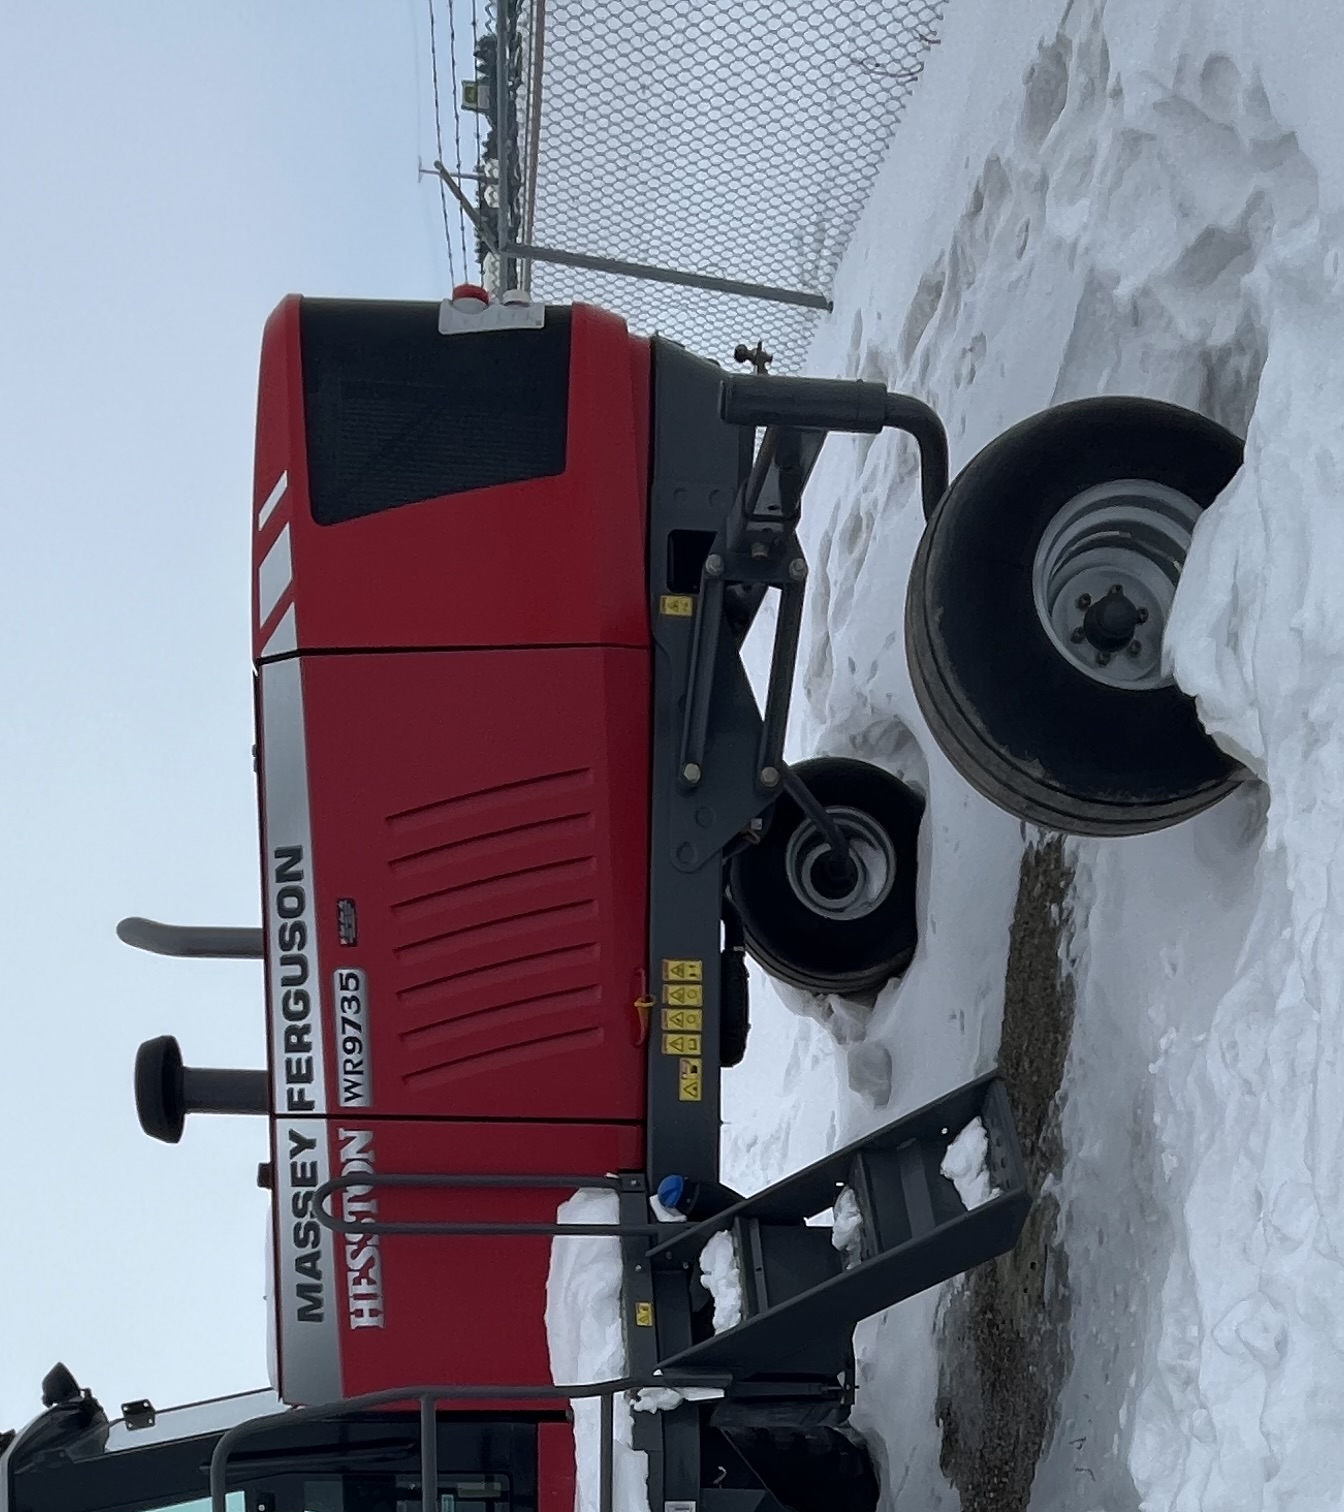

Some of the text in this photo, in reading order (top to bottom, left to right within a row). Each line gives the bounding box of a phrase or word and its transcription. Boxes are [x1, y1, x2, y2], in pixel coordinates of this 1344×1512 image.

[274, 845, 324, 1323] MASSEY FERGUSON
[338, 972, 364, 1102] WR9735
[338, 1128, 385, 1330] HESSTON
